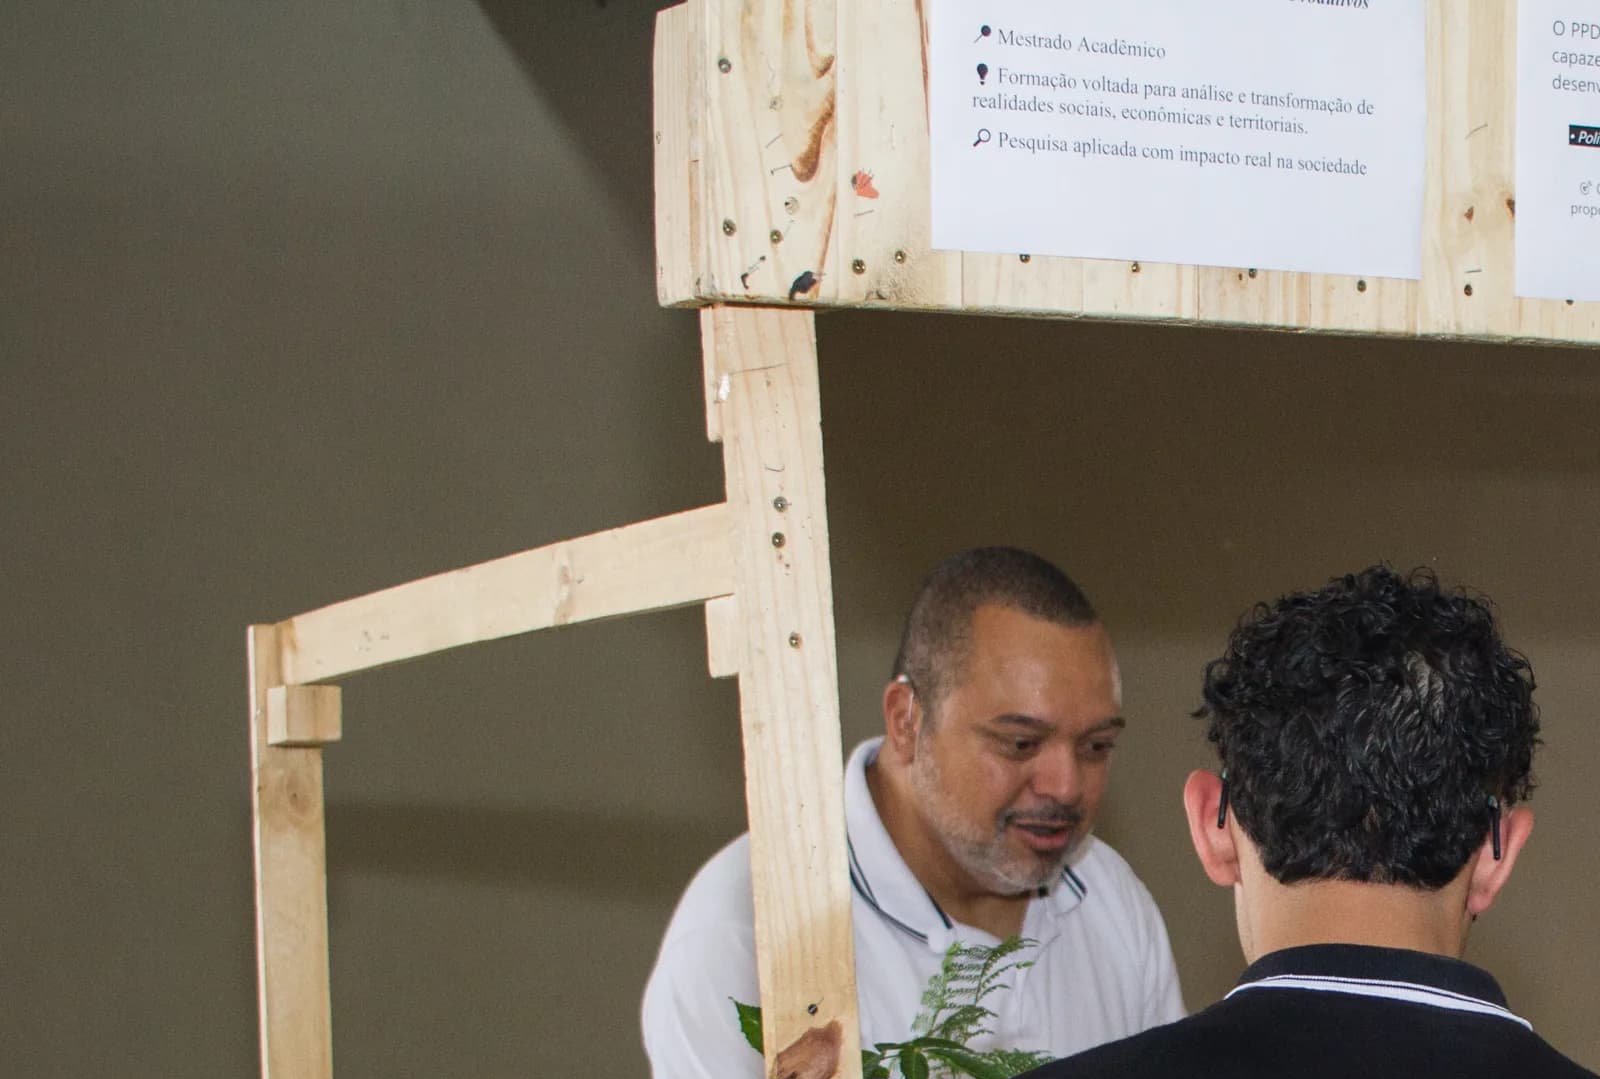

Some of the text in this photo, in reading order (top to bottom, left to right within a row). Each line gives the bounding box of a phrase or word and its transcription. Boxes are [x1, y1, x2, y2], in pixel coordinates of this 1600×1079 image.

[997, 28, 1166, 58] Mestrado Acadêmico
[1551, 19, 1566, 36] O
[997, 66, 1374, 116] Formação voltada para análise e transformação de
[972, 92, 1308, 134] realidades sociais, econômicas e territoriais.
[998, 131, 1367, 176] Pesquisa aplicada com impacto real na sociedade
